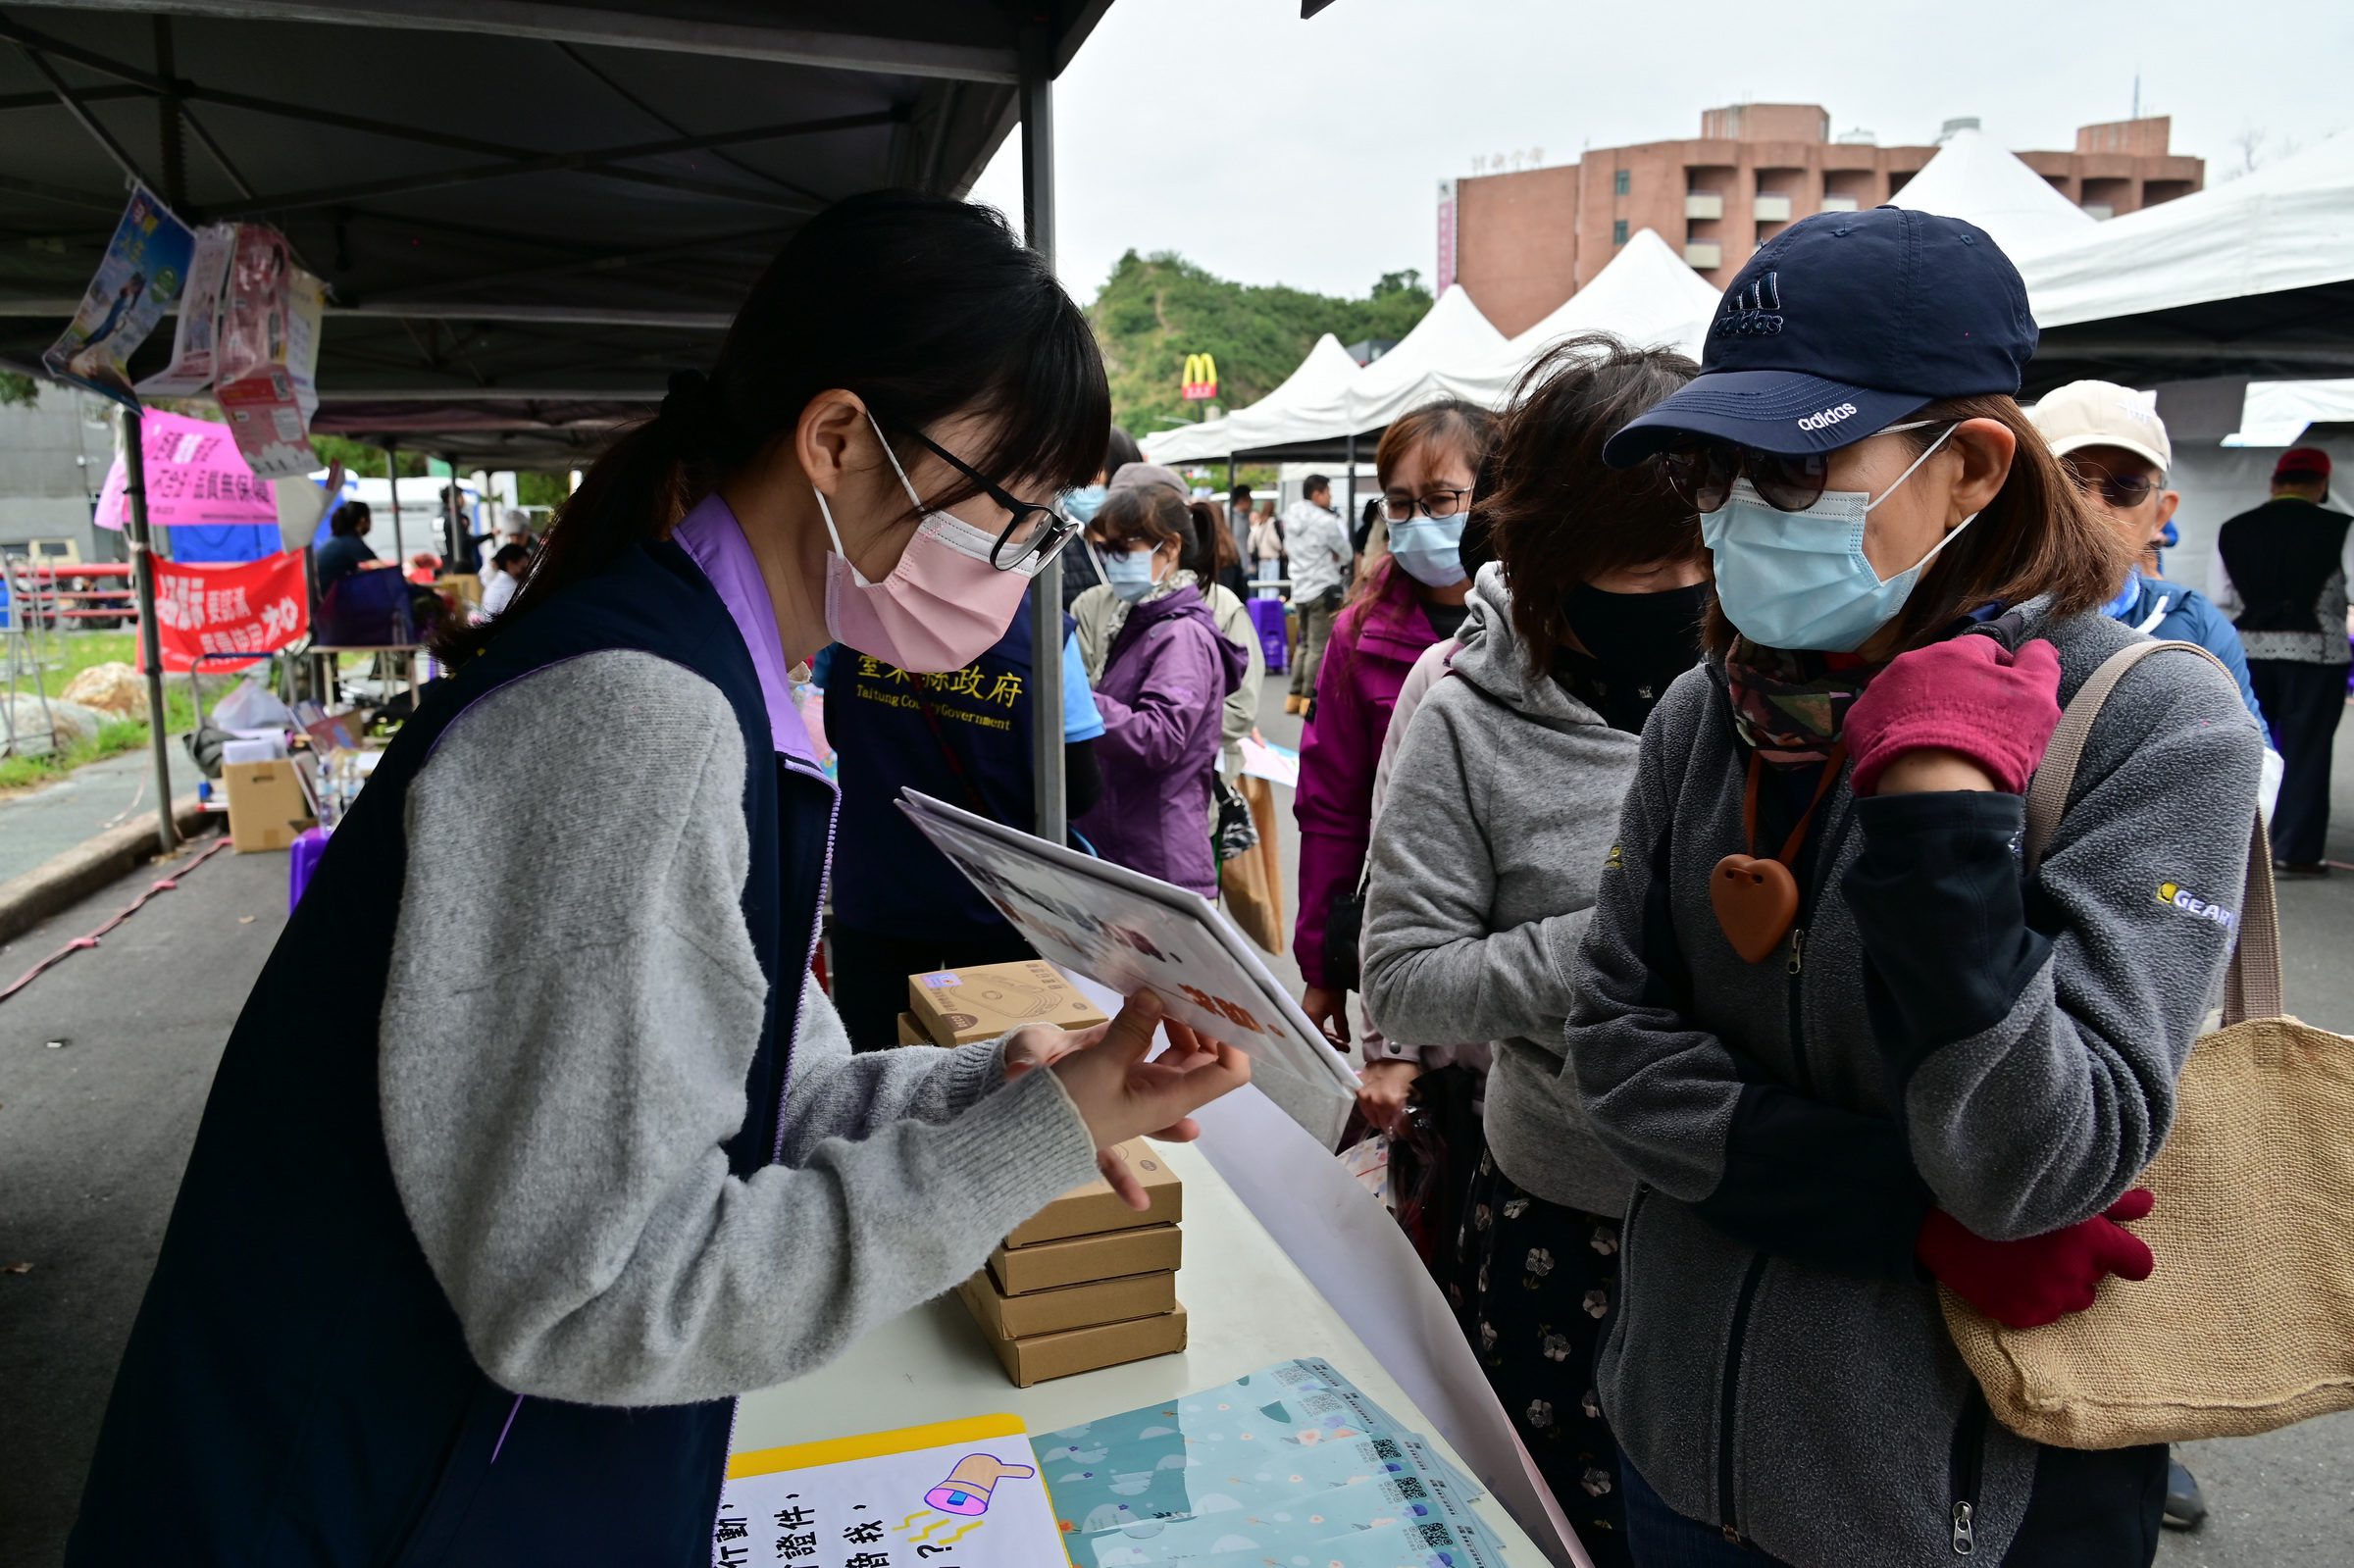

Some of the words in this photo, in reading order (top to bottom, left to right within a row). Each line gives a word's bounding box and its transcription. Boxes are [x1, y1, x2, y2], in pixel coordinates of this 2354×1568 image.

[1715, 311, 1784, 337] adidas
[1798, 402, 1858, 431] adidas
[856, 684, 898, 707] Taitung
[941, 704, 1012, 732] Government
